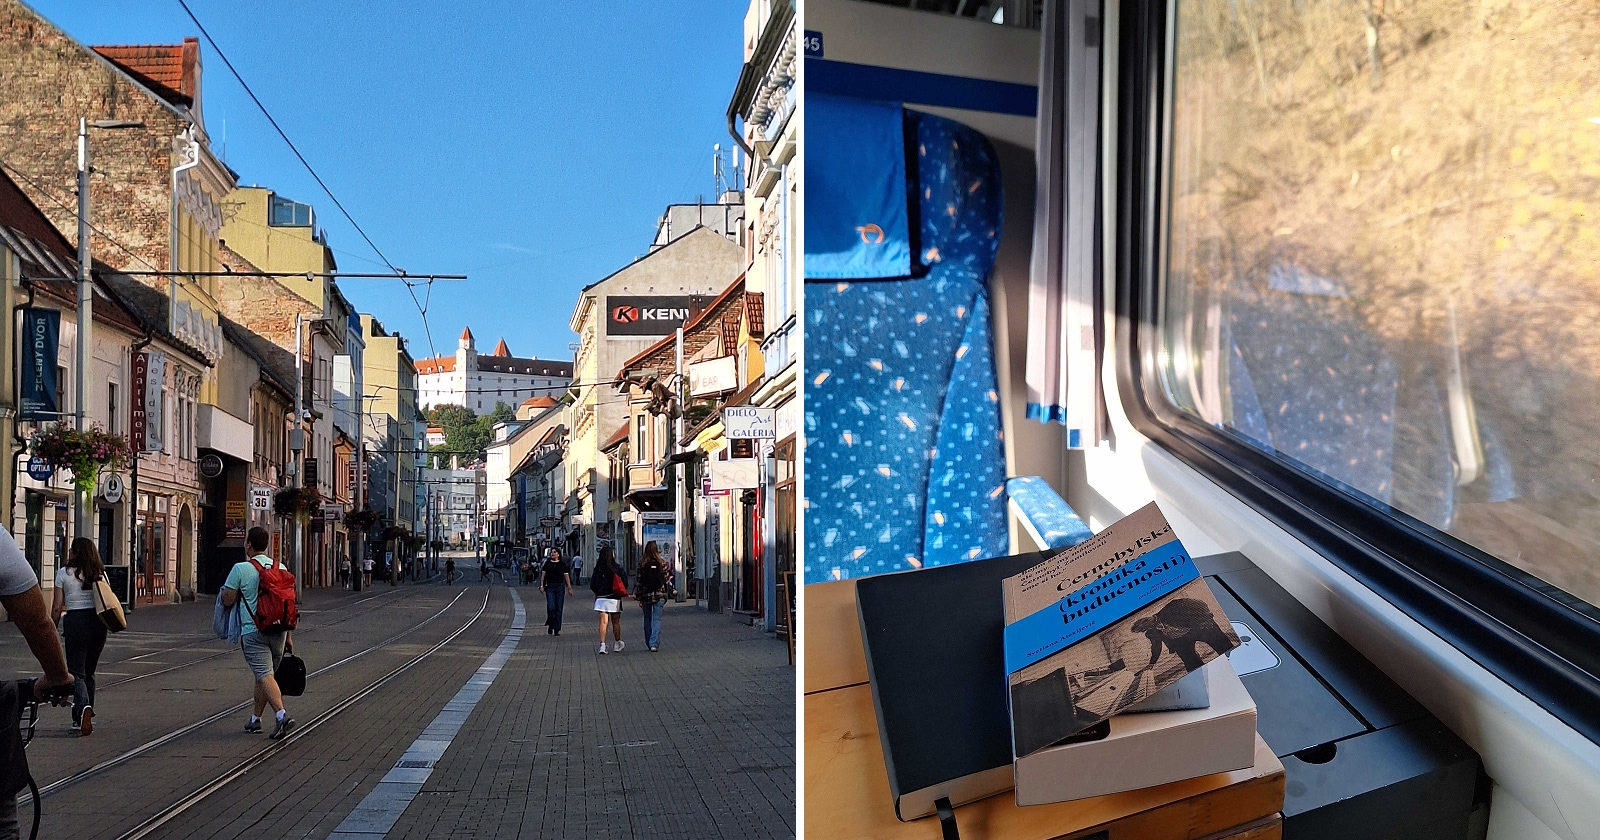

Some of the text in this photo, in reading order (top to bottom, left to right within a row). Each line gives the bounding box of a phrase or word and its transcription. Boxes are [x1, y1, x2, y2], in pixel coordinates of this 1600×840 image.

[35, 317, 46, 349] DVOR
[702, 376, 719, 387] BAR
[727, 409, 757, 417] DIELO
[255, 497, 267, 508] 36
[1056, 522, 1172, 591] Černobyľská
[1059, 560, 1147, 613] (kronika
[1062, 554, 1186, 624] budúcnosti)
[1026, 640, 1059, 658] Svetlana
